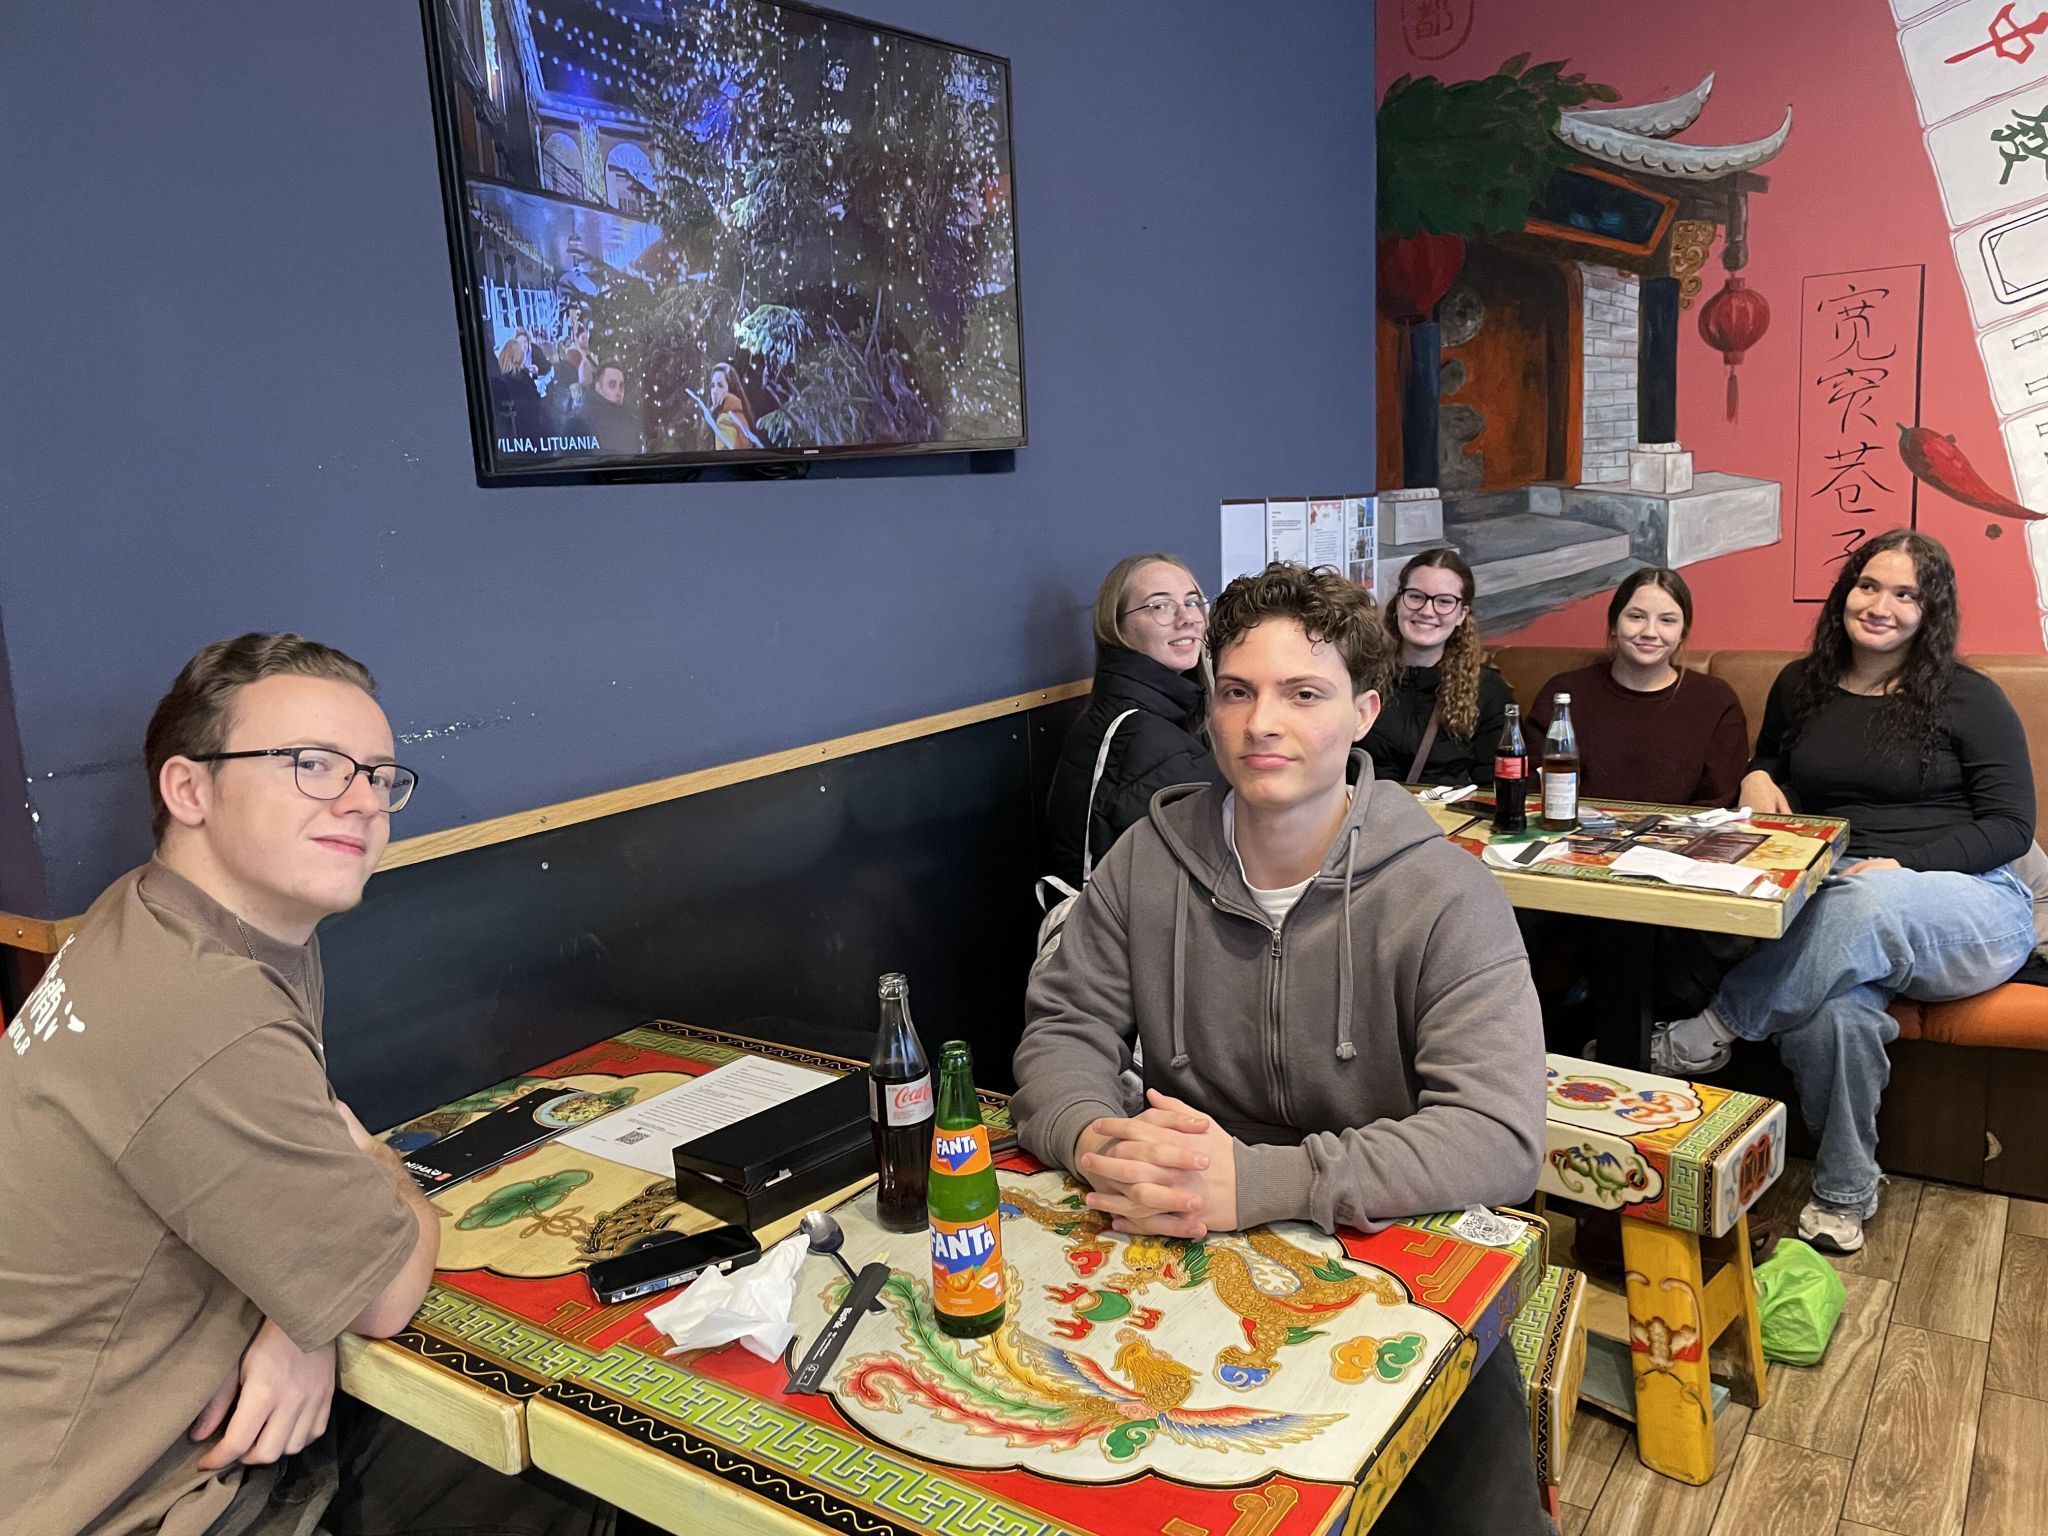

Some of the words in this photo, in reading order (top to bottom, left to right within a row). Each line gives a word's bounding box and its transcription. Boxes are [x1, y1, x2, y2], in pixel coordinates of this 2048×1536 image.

[540, 435, 600, 451] LITUANIA
[936, 1135, 978, 1156] FANTA
[929, 1223, 996, 1260] FANTA
